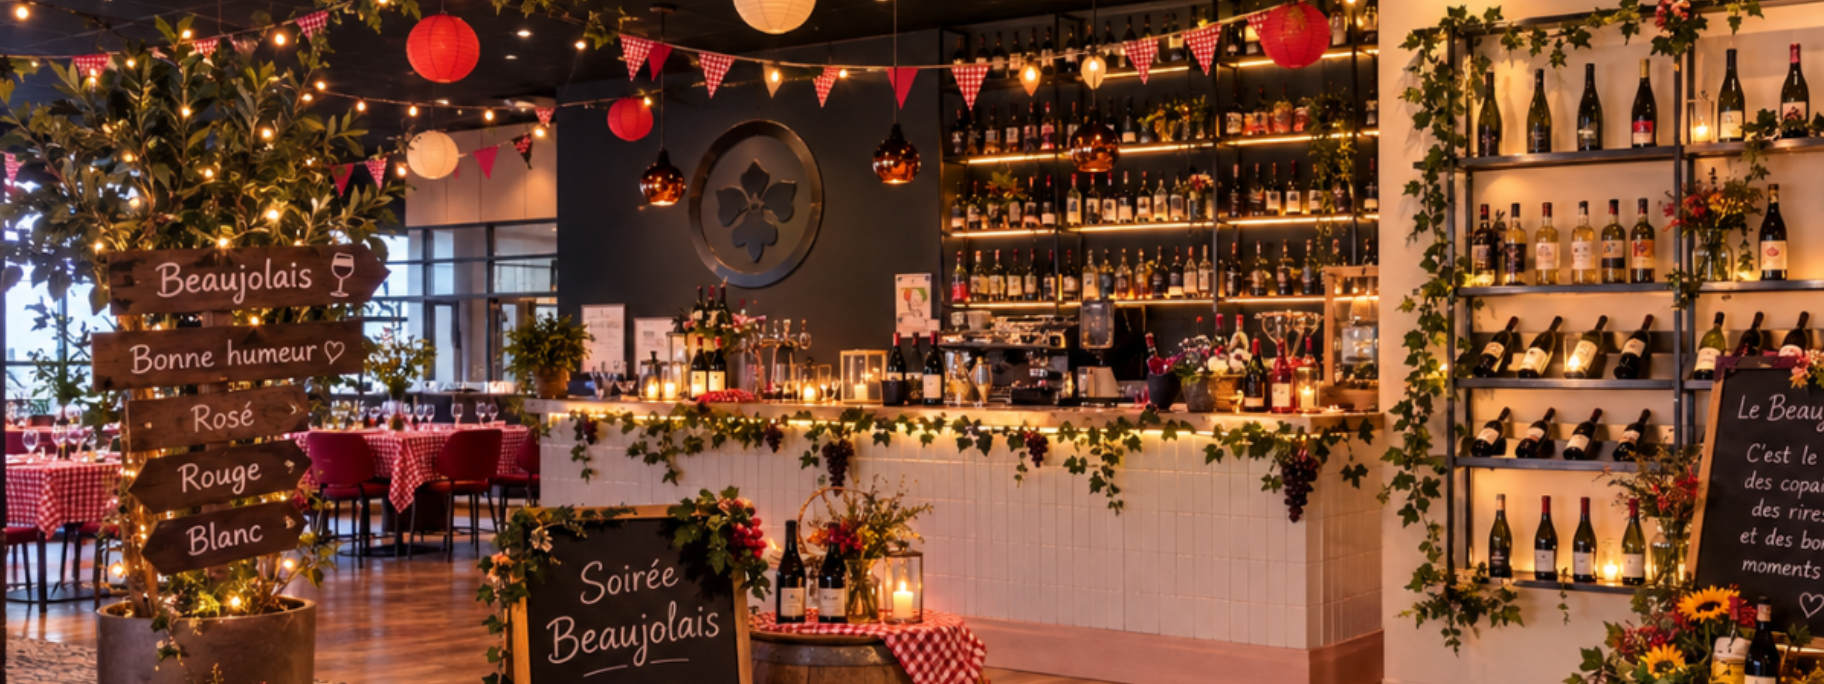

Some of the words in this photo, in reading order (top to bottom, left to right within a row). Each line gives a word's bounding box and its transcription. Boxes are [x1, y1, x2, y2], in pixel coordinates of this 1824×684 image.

[155, 258, 312, 304] Beaujolais
[129, 344, 215, 374] Bonne
[227, 339, 317, 366] humeur
[190, 401, 254, 433] Rosé
[1737, 394, 1760, 420] Le
[1766, 393, 1824, 433] Beau
[1746, 443, 1792, 463] C'est
[1801, 445, 1818, 465] le
[177, 462, 262, 495] Rouge
[1744, 470, 1772, 490] des
[1751, 498, 1780, 519] des
[185, 521, 264, 557] Blanc
[1739, 527, 1758, 545] et
[1764, 527, 1793, 548] des
[579, 558, 679, 605] Soirée
[1741, 560, 1821, 580] moments
[545, 600, 720, 667] Beaujolais
